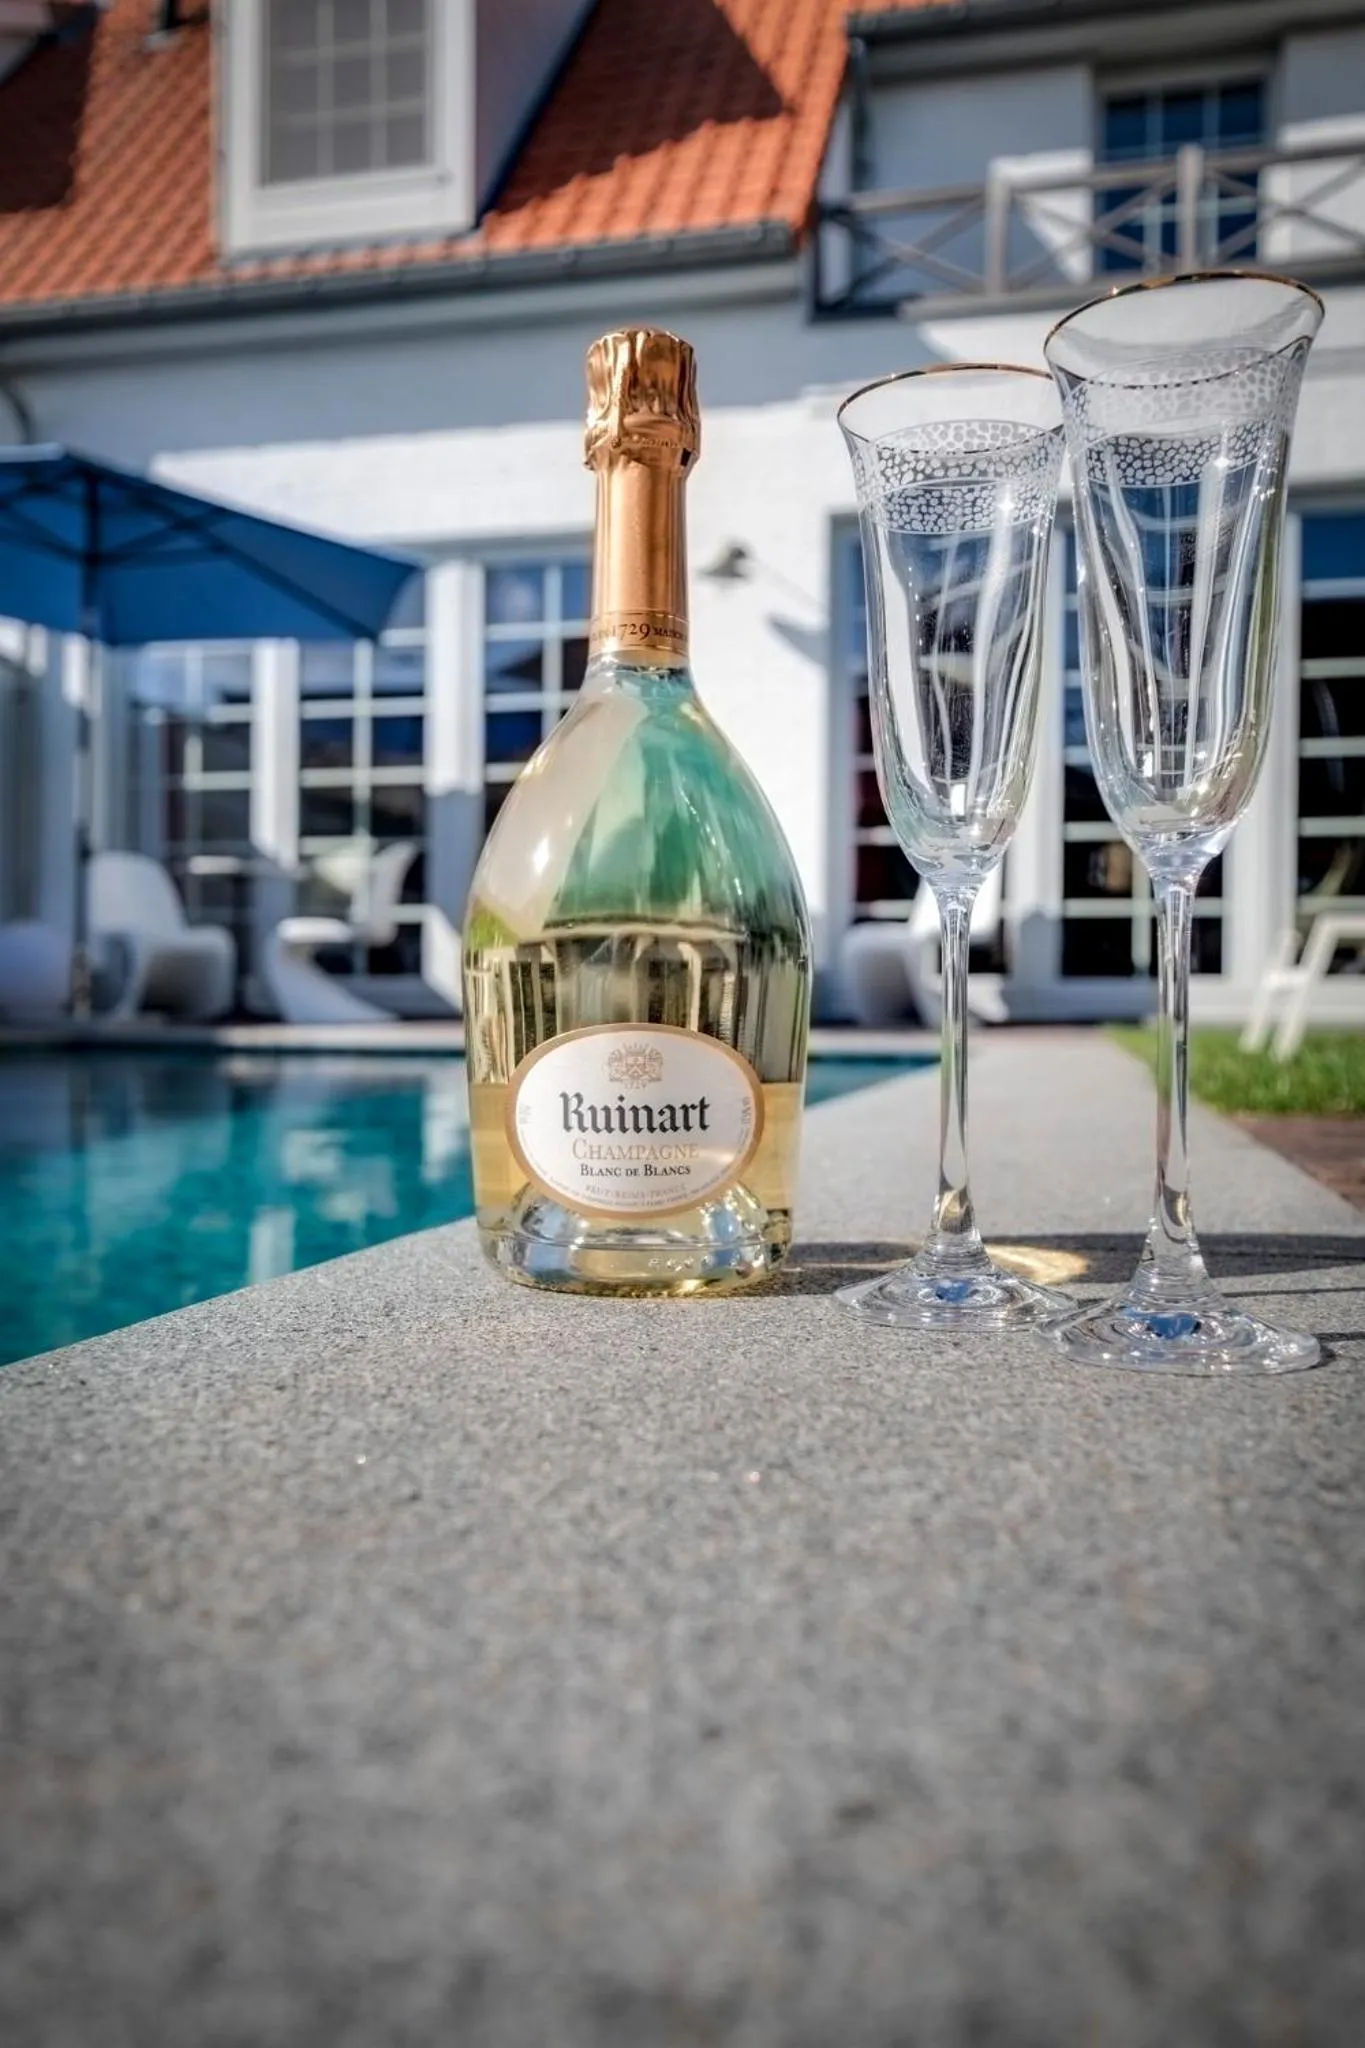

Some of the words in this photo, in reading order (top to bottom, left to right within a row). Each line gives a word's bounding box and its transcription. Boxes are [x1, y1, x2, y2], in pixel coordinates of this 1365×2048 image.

[612, 623, 651, 641] 1729
[560, 1091, 711, 1134] Ruinart
[572, 1138, 700, 1161] CHAMPAGNE
[580, 1163, 622, 1177] BLANC
[643, 1163, 692, 1178] BLANCS
